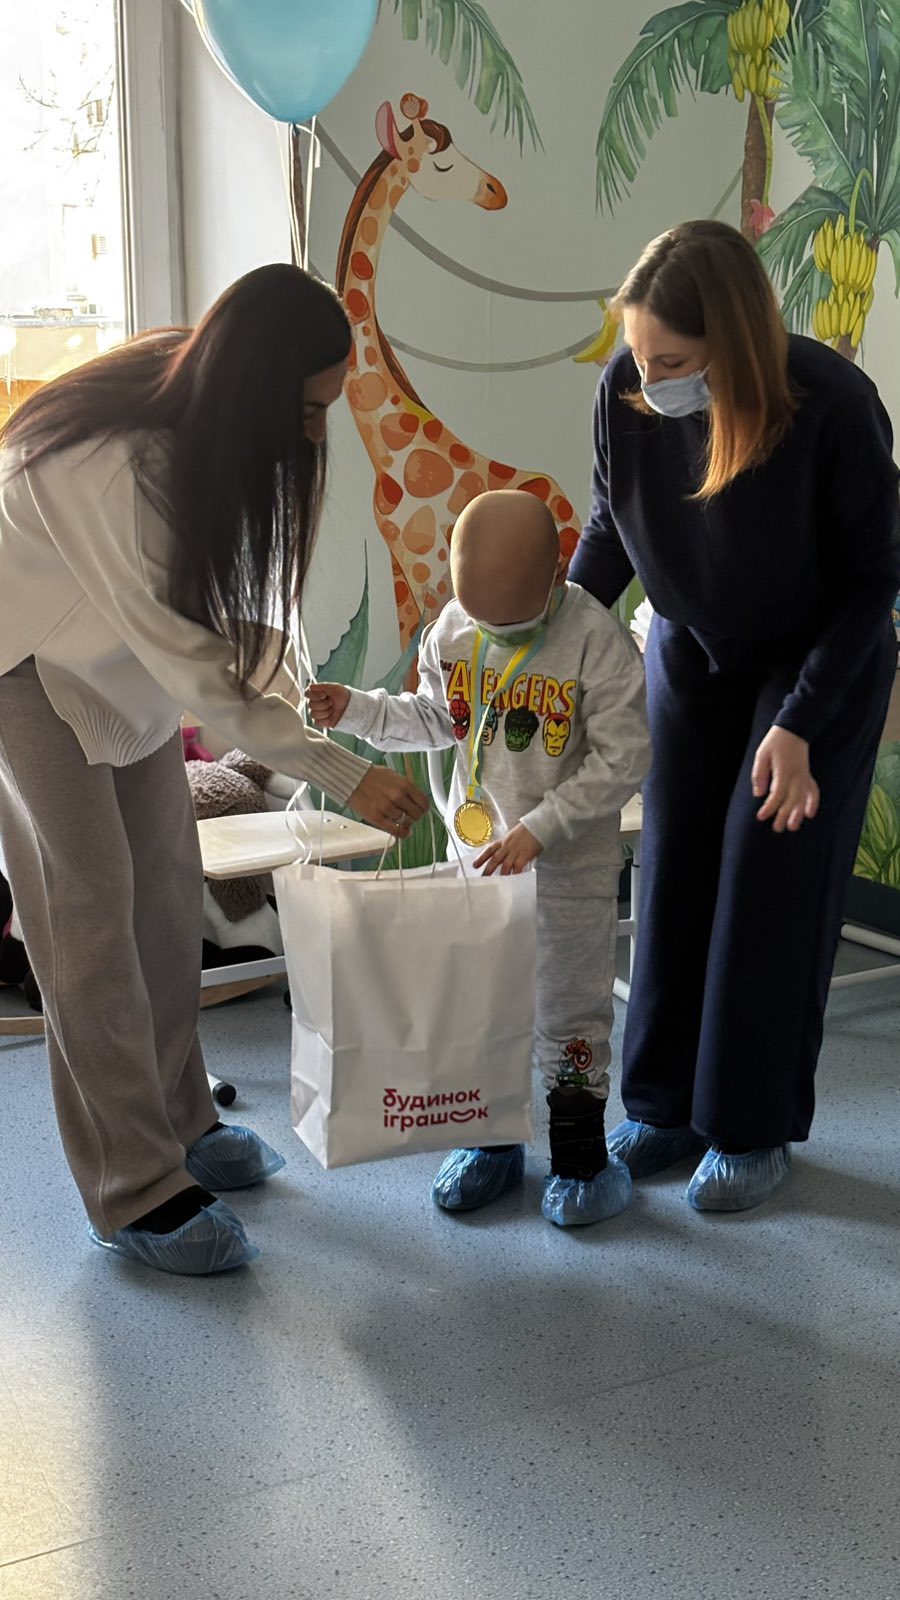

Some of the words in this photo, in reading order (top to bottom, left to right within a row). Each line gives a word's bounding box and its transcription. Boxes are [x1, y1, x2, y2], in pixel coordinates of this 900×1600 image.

[447, 659, 577, 718] AENGERS
[382, 1088, 480, 1112] будинок
[383, 1106, 489, 1132] іграшок
